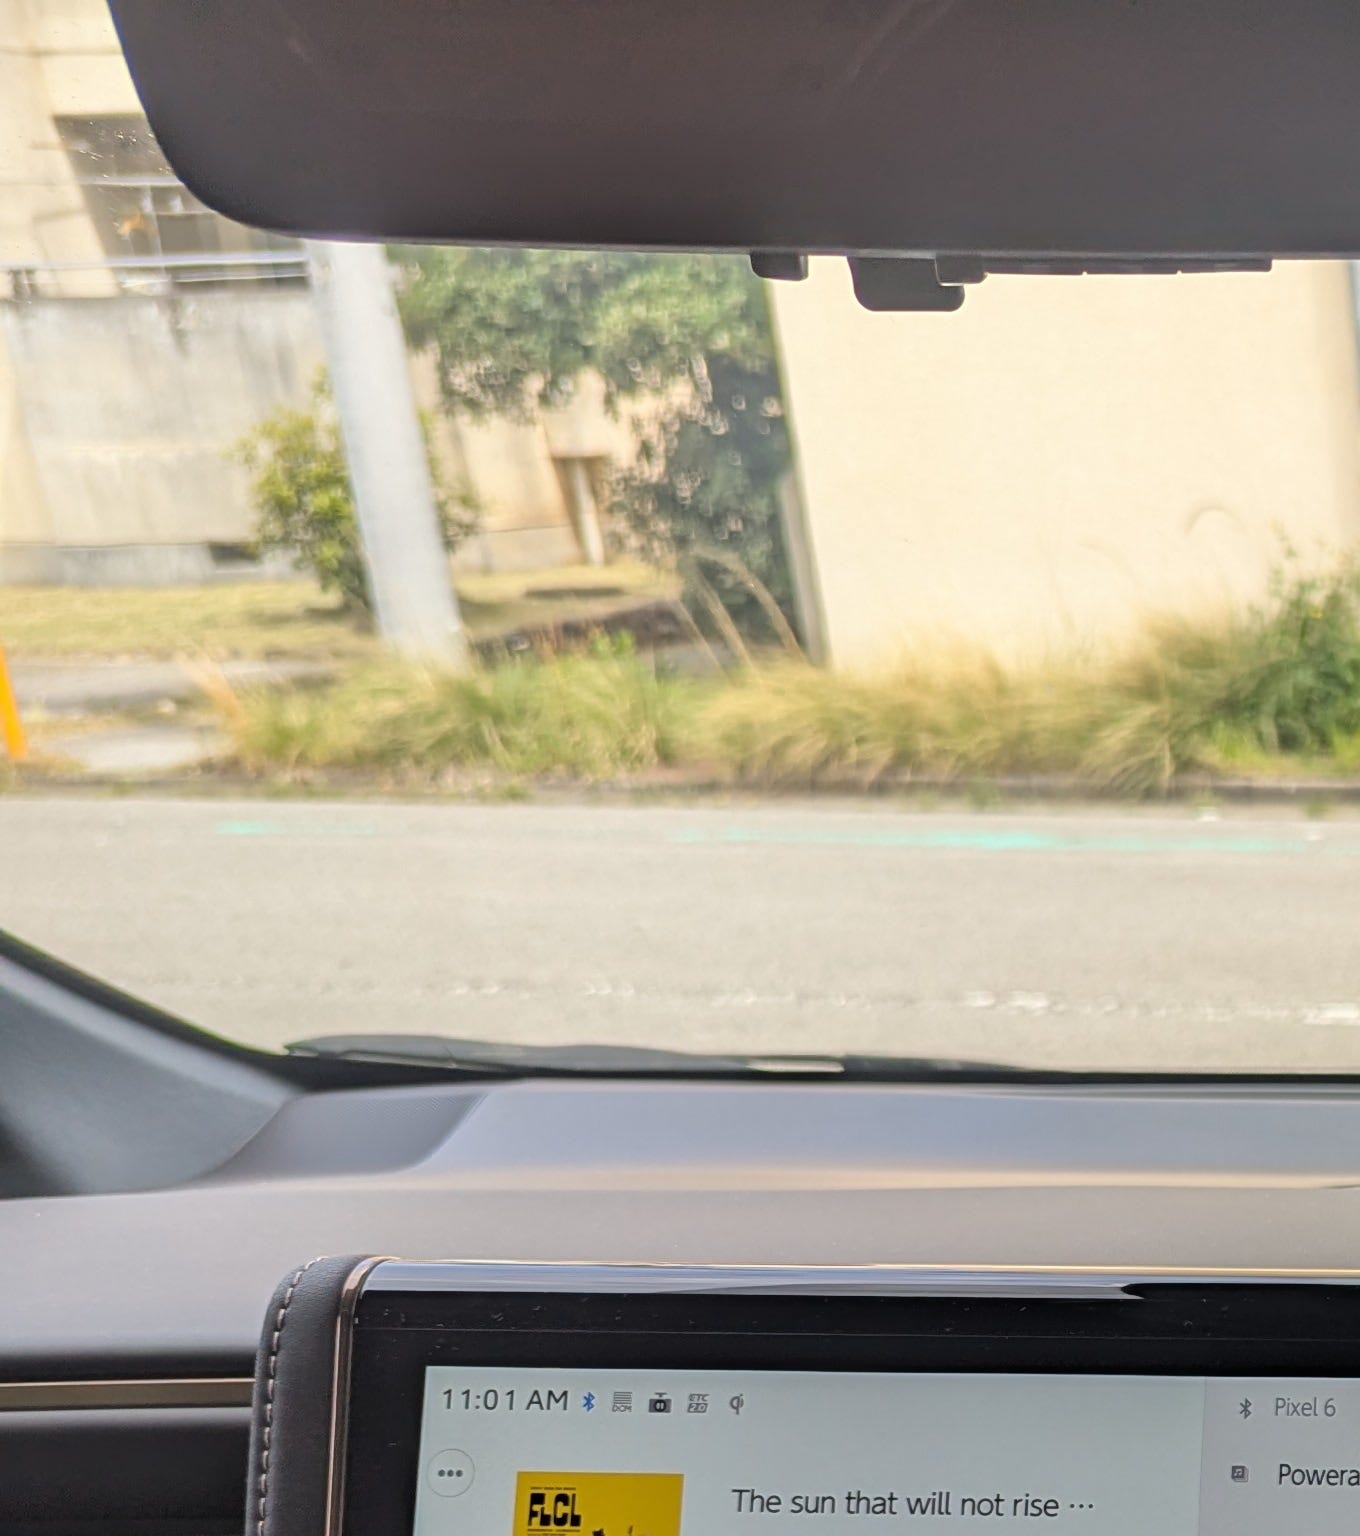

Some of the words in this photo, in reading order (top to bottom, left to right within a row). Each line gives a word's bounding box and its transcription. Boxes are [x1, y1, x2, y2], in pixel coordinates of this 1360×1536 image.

[441, 1388, 518, 1412] 11:01
[526, 1389, 570, 1412] AM
[1274, 1398, 1318, 1418] Pixel
[1324, 1399, 1337, 1418] 6
[528, 1493, 582, 1526] FLCL
[732, 1489, 781, 1513] The
[790, 1494, 835, 1514] sun
[846, 1490, 898, 1515] that
[907, 1492, 951, 1516] will
[961, 1494, 1004, 1517] not
[1013, 1493, 1059, 1517] rise
